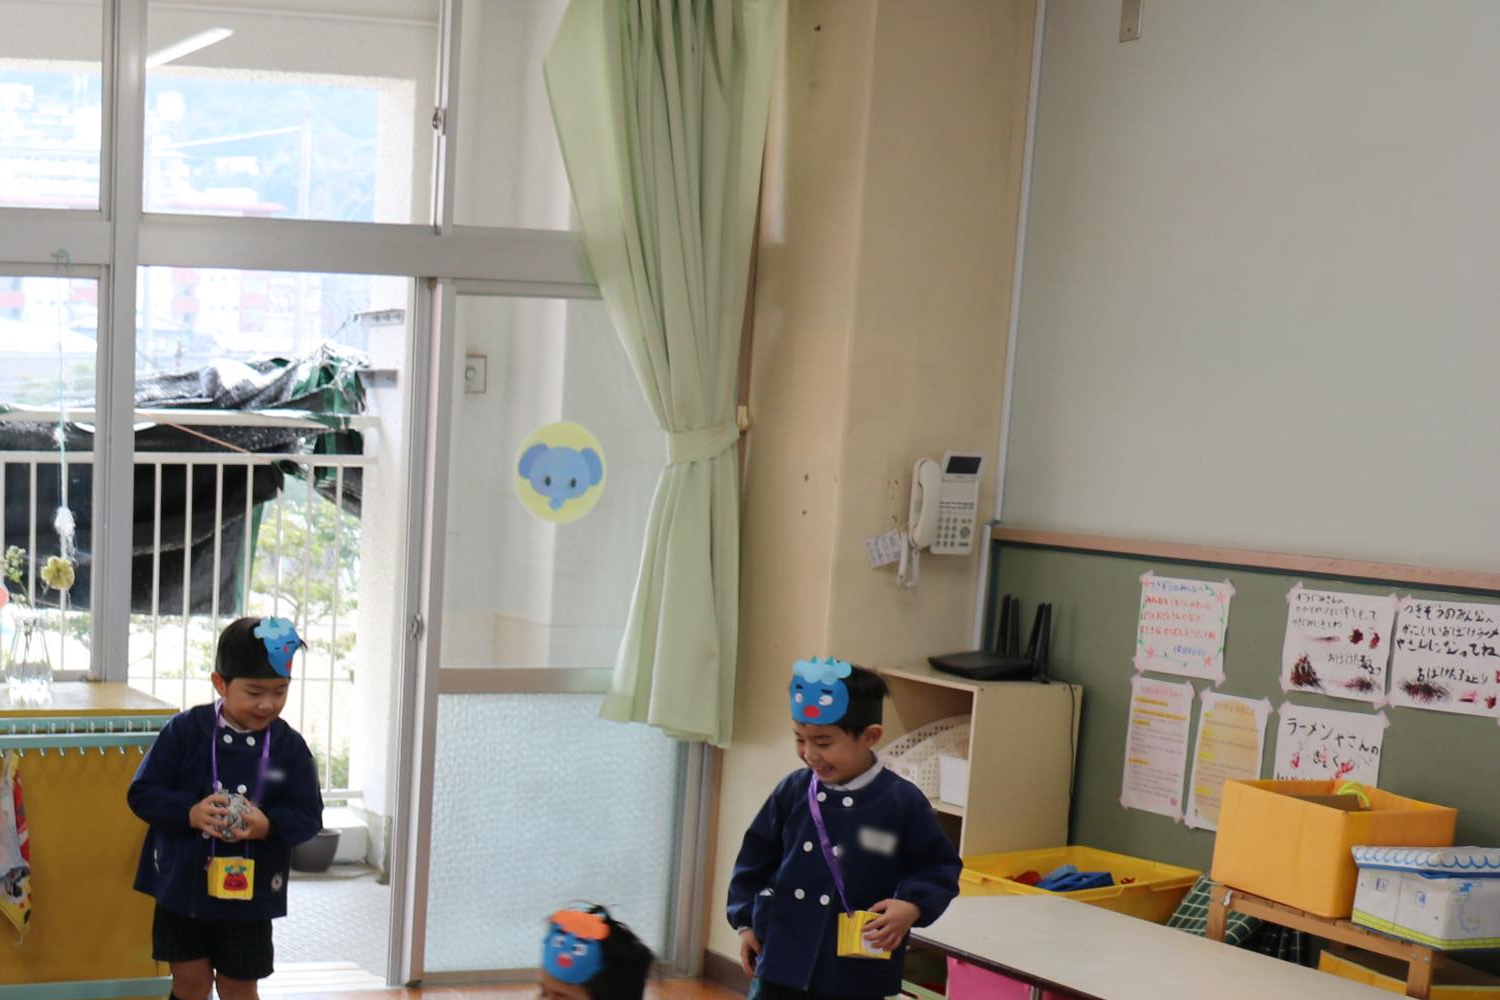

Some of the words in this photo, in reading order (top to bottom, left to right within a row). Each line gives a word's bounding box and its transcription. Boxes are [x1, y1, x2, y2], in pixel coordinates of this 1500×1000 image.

[1287, 717, 1379, 756] ラーメンやさんの
